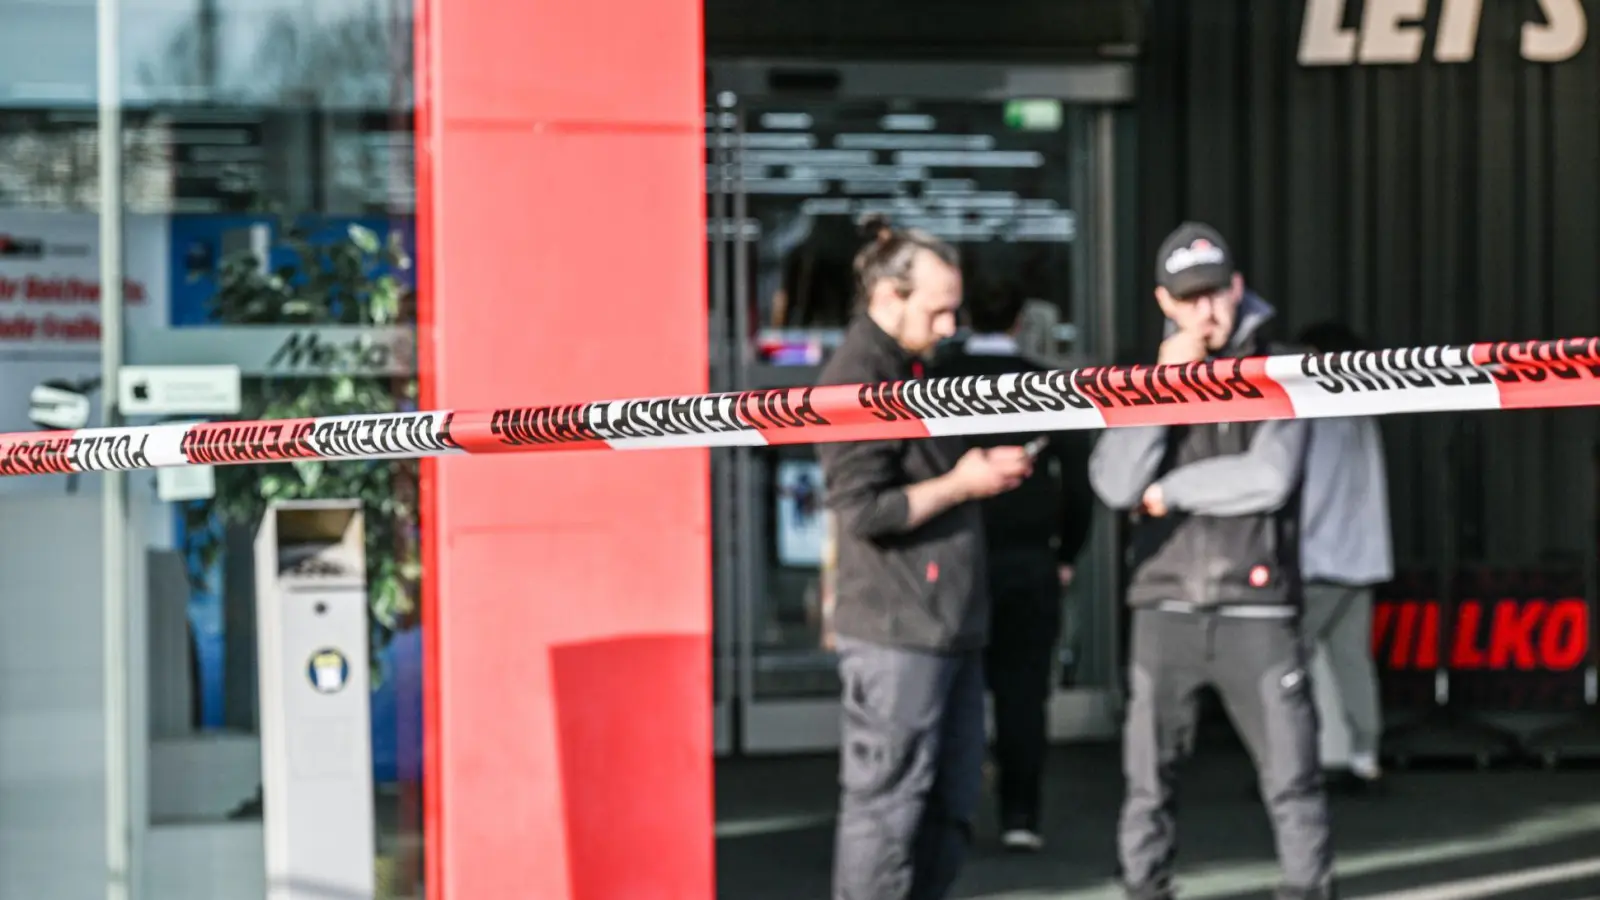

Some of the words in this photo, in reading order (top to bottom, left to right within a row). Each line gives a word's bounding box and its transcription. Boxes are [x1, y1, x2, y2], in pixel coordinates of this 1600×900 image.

[1297, 0, 1588, 65] LETS
[491, 387, 831, 446] POLIZEIABSPERRUNG
[858, 358, 1263, 422] POLIZEIABSPERRUNG
